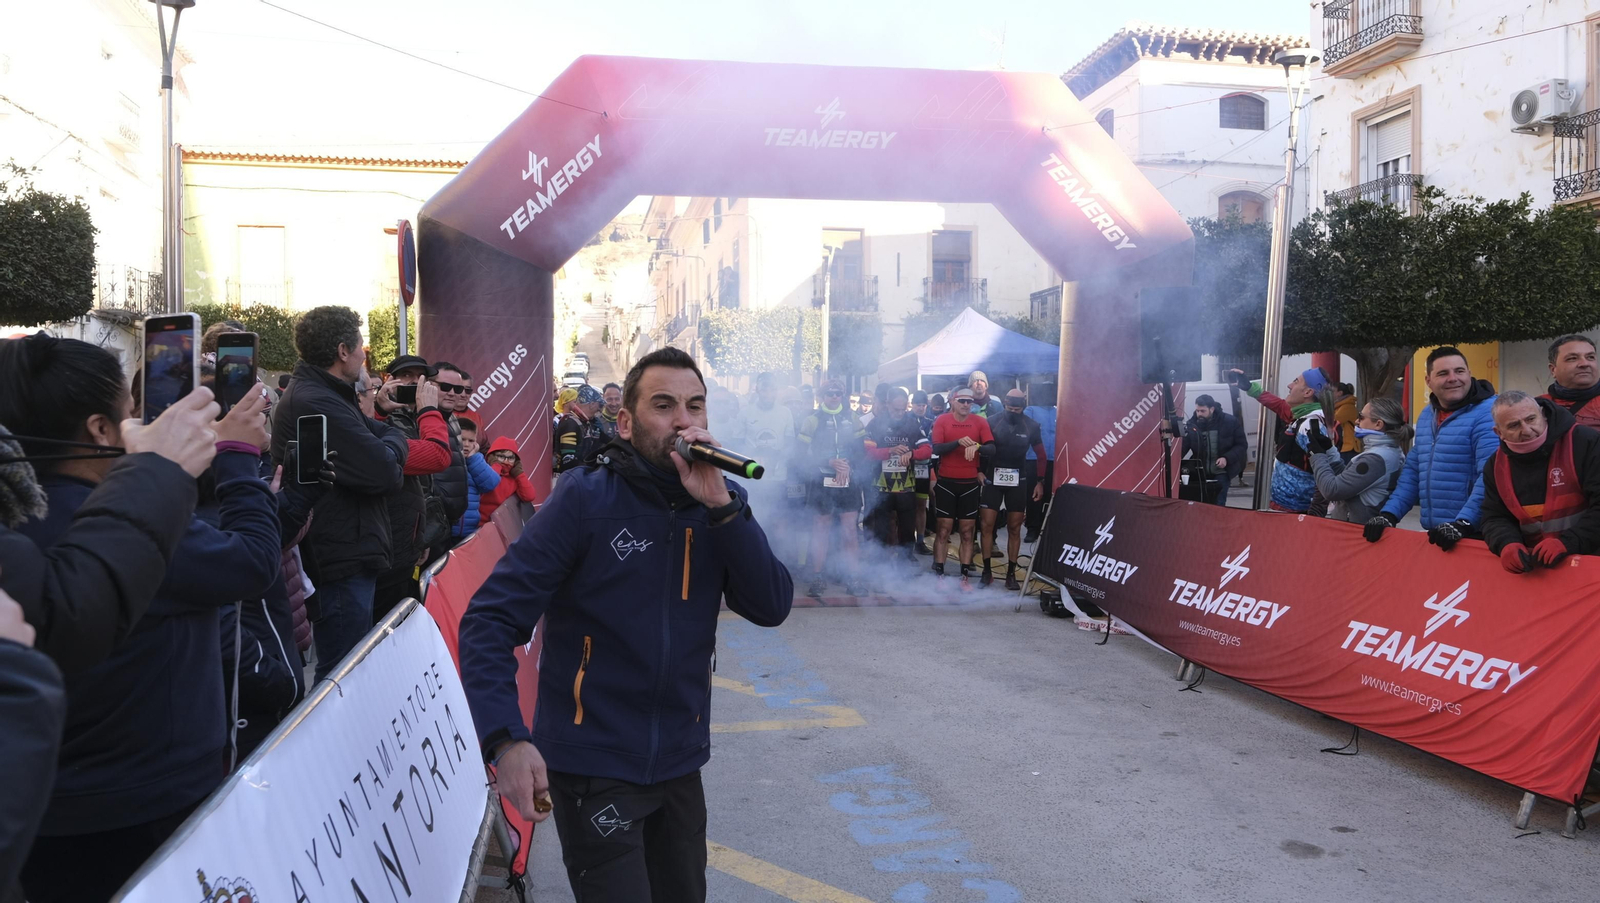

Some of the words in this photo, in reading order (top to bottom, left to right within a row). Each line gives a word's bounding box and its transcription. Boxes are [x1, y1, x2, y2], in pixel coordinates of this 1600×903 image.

[764, 127, 898, 150] TEAMERGY
[499, 133, 603, 240] TEAMERGY
[1040, 152, 1137, 250] TEAMERGY
[467, 343, 528, 412] mergy.es
[1082, 383, 1164, 468] www.teamer
[999, 473, 1014, 482] 238
[1058, 543, 1139, 585] TEAMERGY
[1063, 577, 1106, 599] www.teamergy.es
[1168, 578, 1291, 629] TEAMERGY
[1178, 619, 1241, 647] www.teamergy.es
[1341, 620, 1538, 694] TEAMERGY
[290, 684, 426, 903] AYUNTAMIENTO
[423, 662, 443, 700] DE
[350, 703, 467, 903] NTORIA
